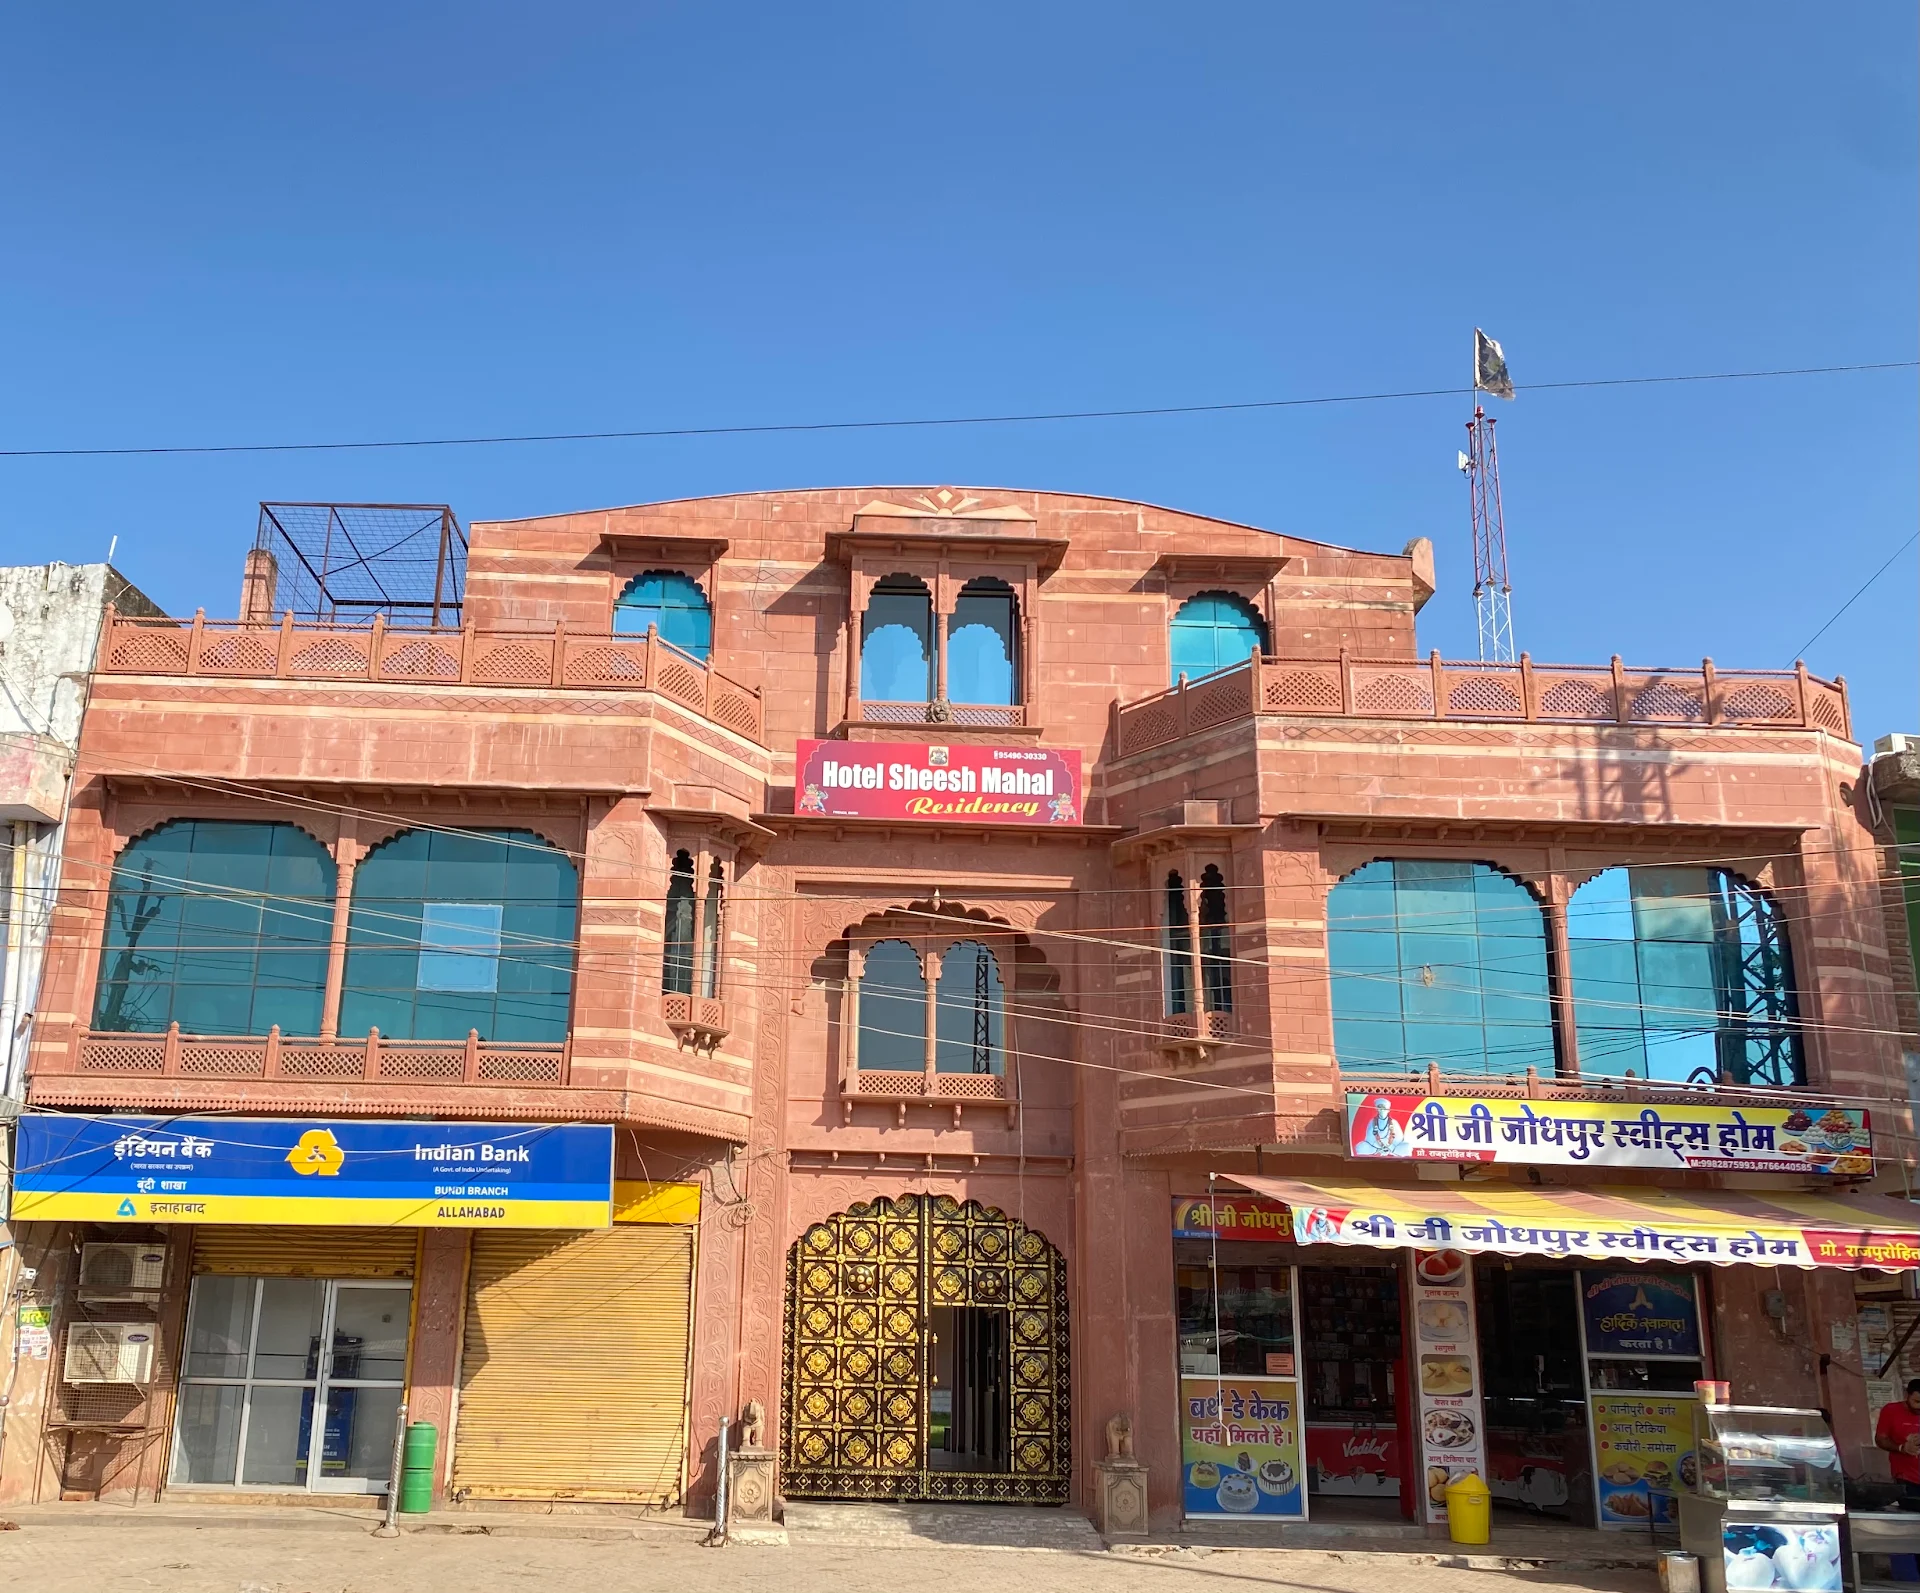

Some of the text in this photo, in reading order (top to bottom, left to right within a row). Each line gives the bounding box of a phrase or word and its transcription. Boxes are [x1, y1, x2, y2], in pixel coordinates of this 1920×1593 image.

[822, 760, 1054, 796] Hotel Sheesh Mahal
[905, 796, 1041, 817] Residency
[1412, 1102, 1777, 1162] श्री जी जोधपुर स्वीट्स होम
[114, 1134, 214, 1161] इंडियन बैंक
[415, 1143, 530, 1162] Indian Bank
[161, 1180, 187, 1190] शाखा
[434, 1186, 508, 1196] BUNDI BRANCH
[150, 1202, 206, 1214] इलाहाबाद
[437, 1206, 505, 1218] ALLAHABAD
[1191, 1203, 1212, 1227] श्री
[1215, 1204, 1238, 1228] जी
[1351, 1214, 1799, 1258] श्री जी जोधपुर स्वीट्स होम
[1820, 1243, 1841, 1257] प्रो.
[1619, 1339, 1652, 1349] करता
[1654, 1337, 1663, 1349] है
[1249, 1390, 1290, 1420] केक
[1610, 1403, 1644, 1417] पानीपुरी
[1192, 1423, 1220, 1444] यहाँ
[1228, 1424, 1269, 1443] मिलते
[1612, 1423, 1633, 1435] आलू
[1343, 1436, 1389, 1461] Vadilal
